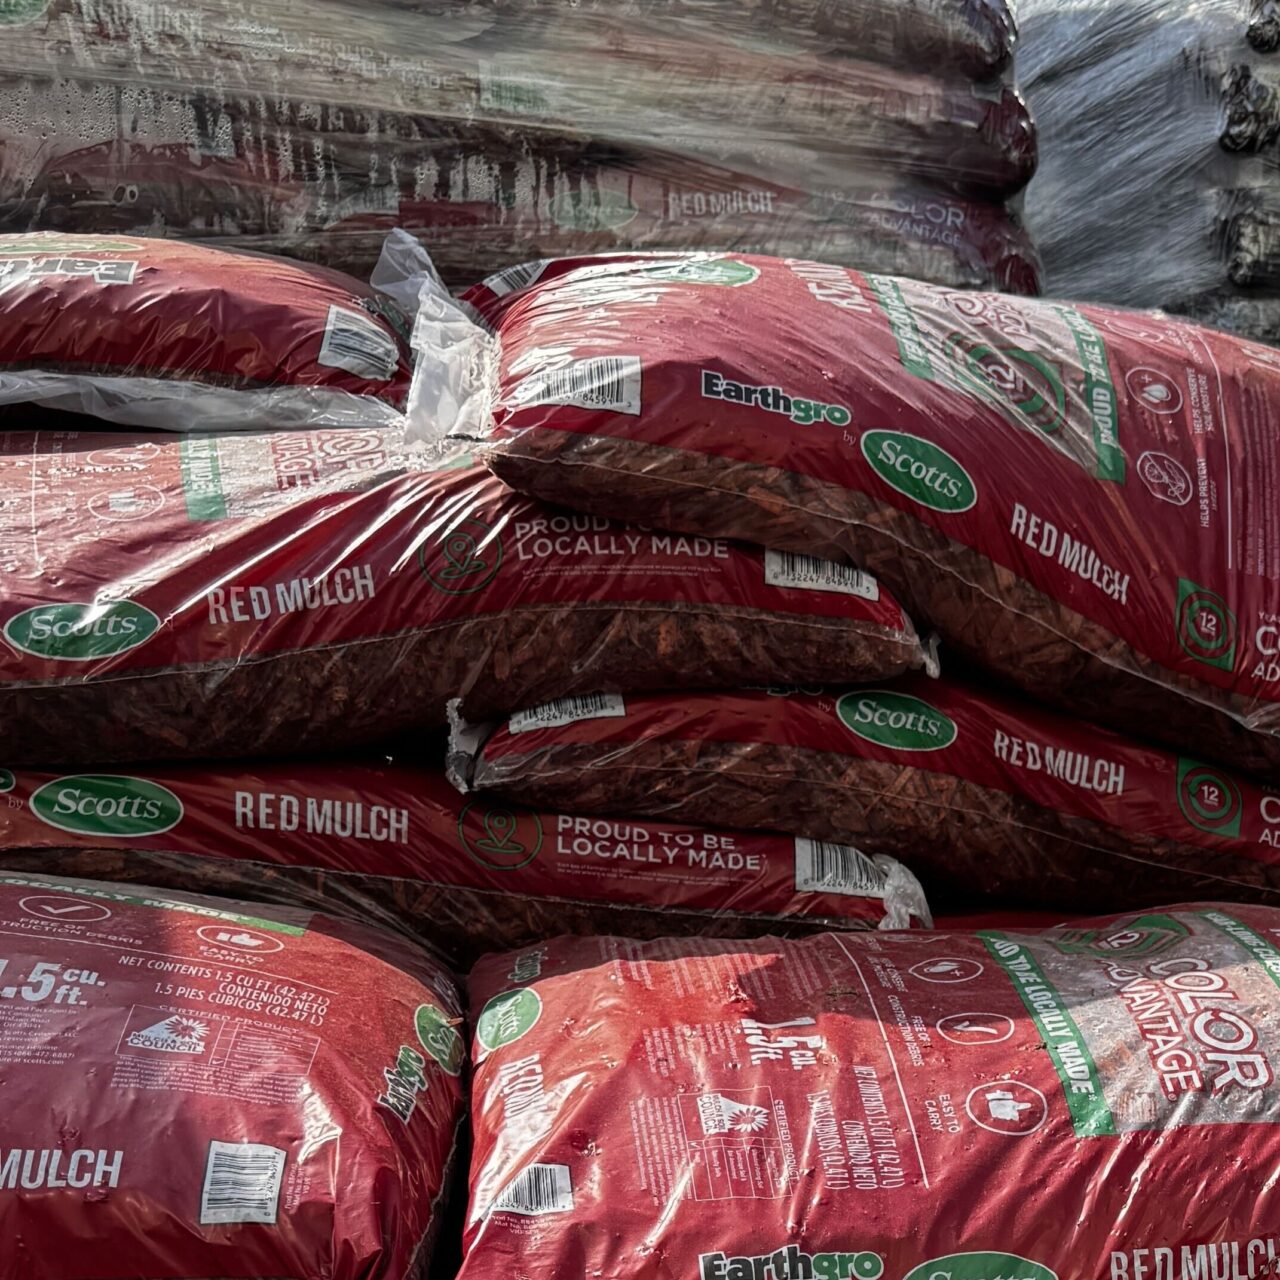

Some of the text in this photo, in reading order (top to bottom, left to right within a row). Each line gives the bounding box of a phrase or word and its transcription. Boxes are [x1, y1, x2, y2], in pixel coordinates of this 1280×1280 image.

[668, 192, 774, 220] RED MULCH
[702, 370, 852, 425] Earthgro
[843, 429, 963, 498] by Scotts
[517, 533, 729, 561] LOCALLY MADE
[1010, 503, 1130, 606] RED MULCH
[207, 586, 270, 625] RED
[277, 564, 376, 613] MULCH
[854, 700, 941, 738] Scotts
[994, 729, 1125, 796] RED MULCH
[52, 788, 409, 845] Scotts RED MULCH
[557, 815, 735, 850] PROUD TO BE
[557, 837, 679, 865] LOCALLY
[62, 967, 107, 987] cu.
[118, 955, 145, 968] NET
[147, 958, 212, 980] CONTENTS
[214, 970, 233, 983] 1.5
[236, 973, 254, 987] CU
[256, 977, 271, 990] FT
[54, 983, 88, 1006] ft.
[154, 982, 172, 995] 1.5
[175, 986, 204, 1001] PIES
[207, 991, 262, 1013] CUBICOS
[218, 981, 328, 1016] CONTENIDO NETO
[1024, 985, 1073, 1039] LOCALLY
[1150, 957, 1270, 1090] COLOR
[924, 1099, 944, 1132] CARRY
[938, 1093, 961, 1133] EASY TO
